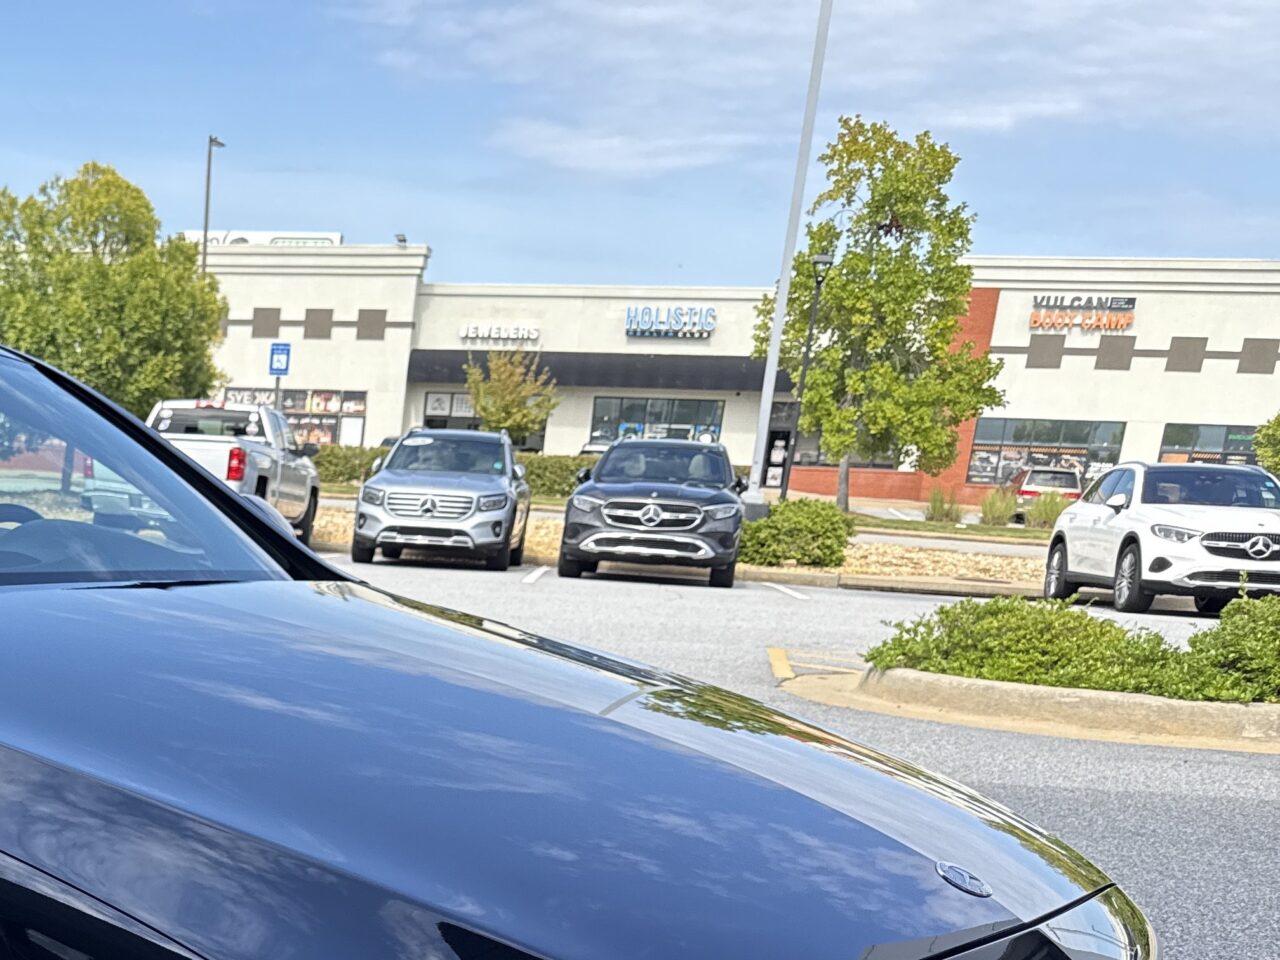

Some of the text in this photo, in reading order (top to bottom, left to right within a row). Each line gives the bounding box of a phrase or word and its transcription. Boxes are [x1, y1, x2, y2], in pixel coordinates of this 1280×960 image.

[1032, 295, 1110, 310] VULCAN
[624, 305, 717, 331] HOLISTIC
[1029, 310, 1135, 330] BOOT CAMP
[458, 323, 539, 340] JEWELERS
